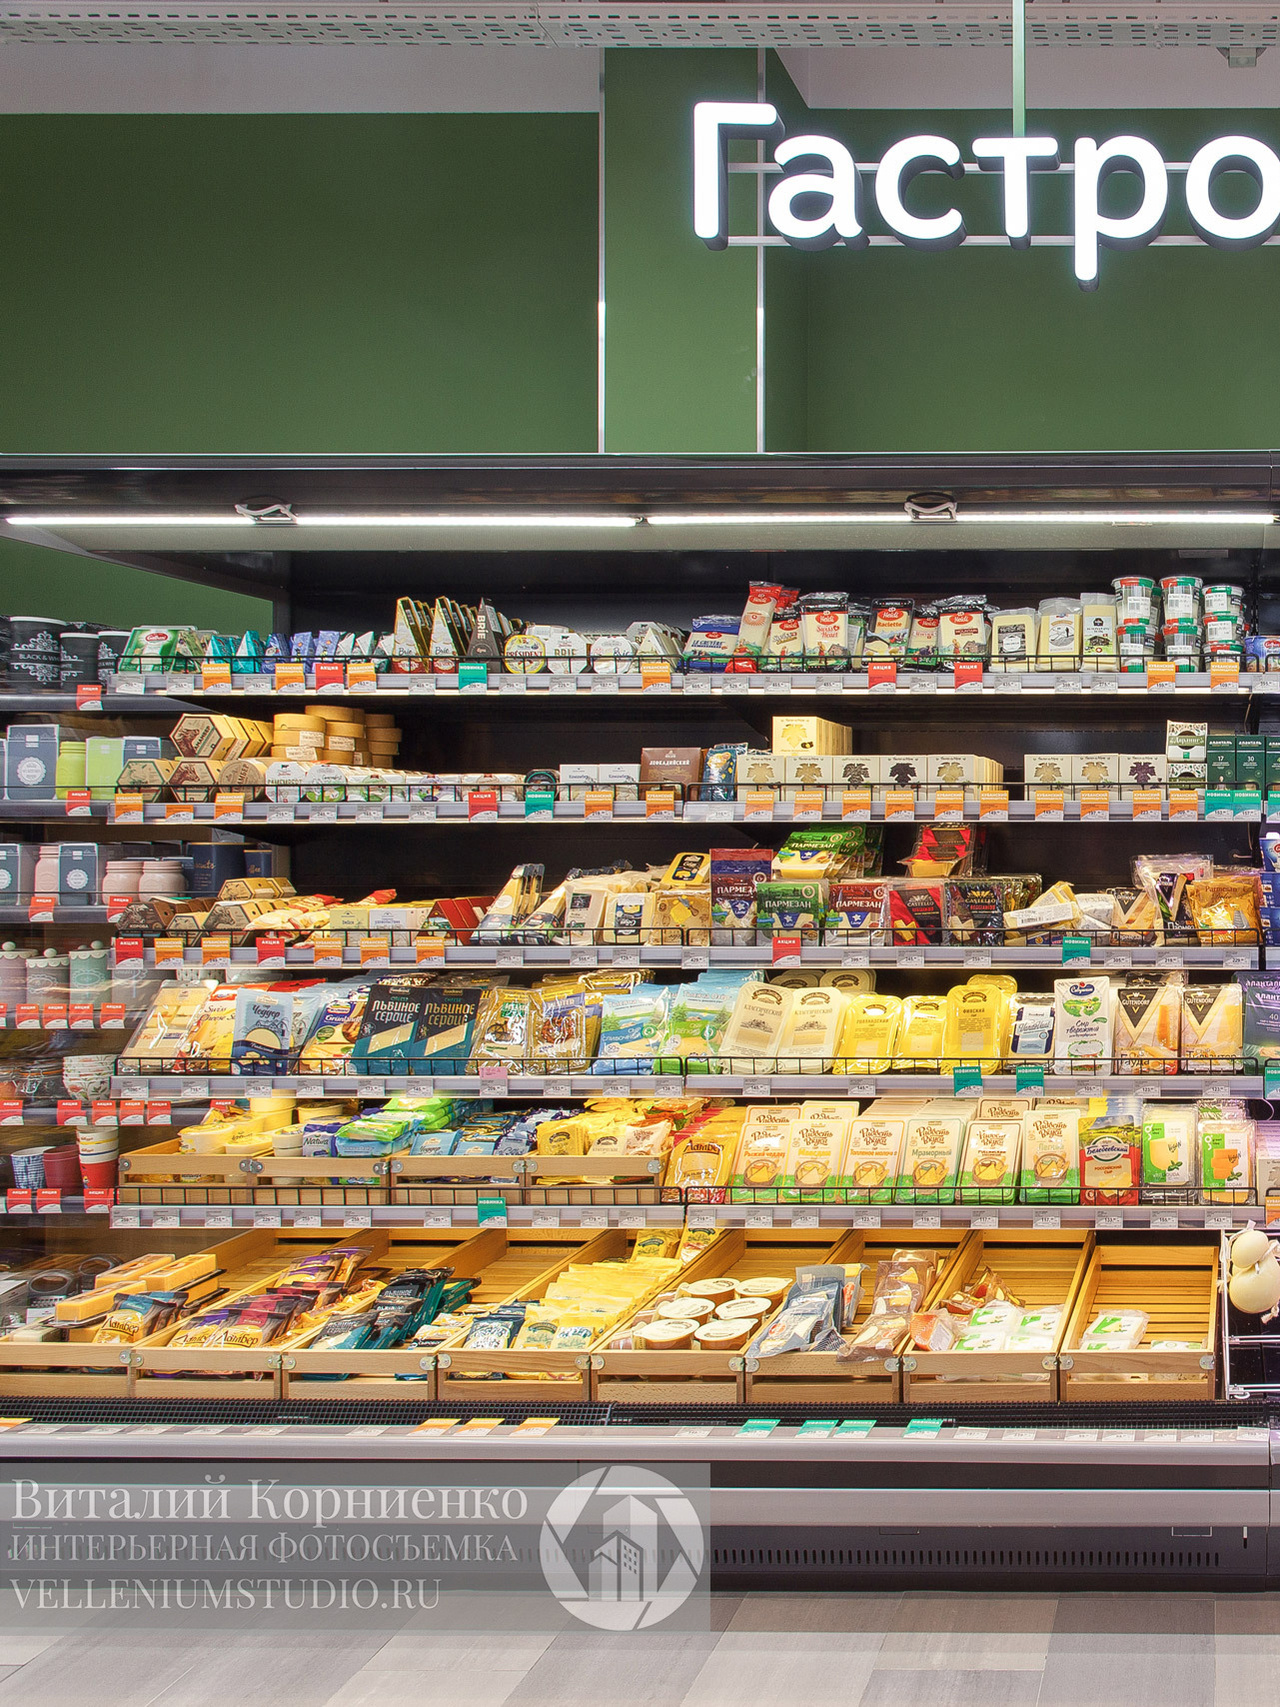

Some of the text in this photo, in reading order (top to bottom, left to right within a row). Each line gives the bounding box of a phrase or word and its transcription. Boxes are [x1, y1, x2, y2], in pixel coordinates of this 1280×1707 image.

[765, 900, 812, 908] ПАРМЕЗАН
[105, 1317, 139, 1334] Ламбер
[215, 1331, 258, 1347] Ламбер
